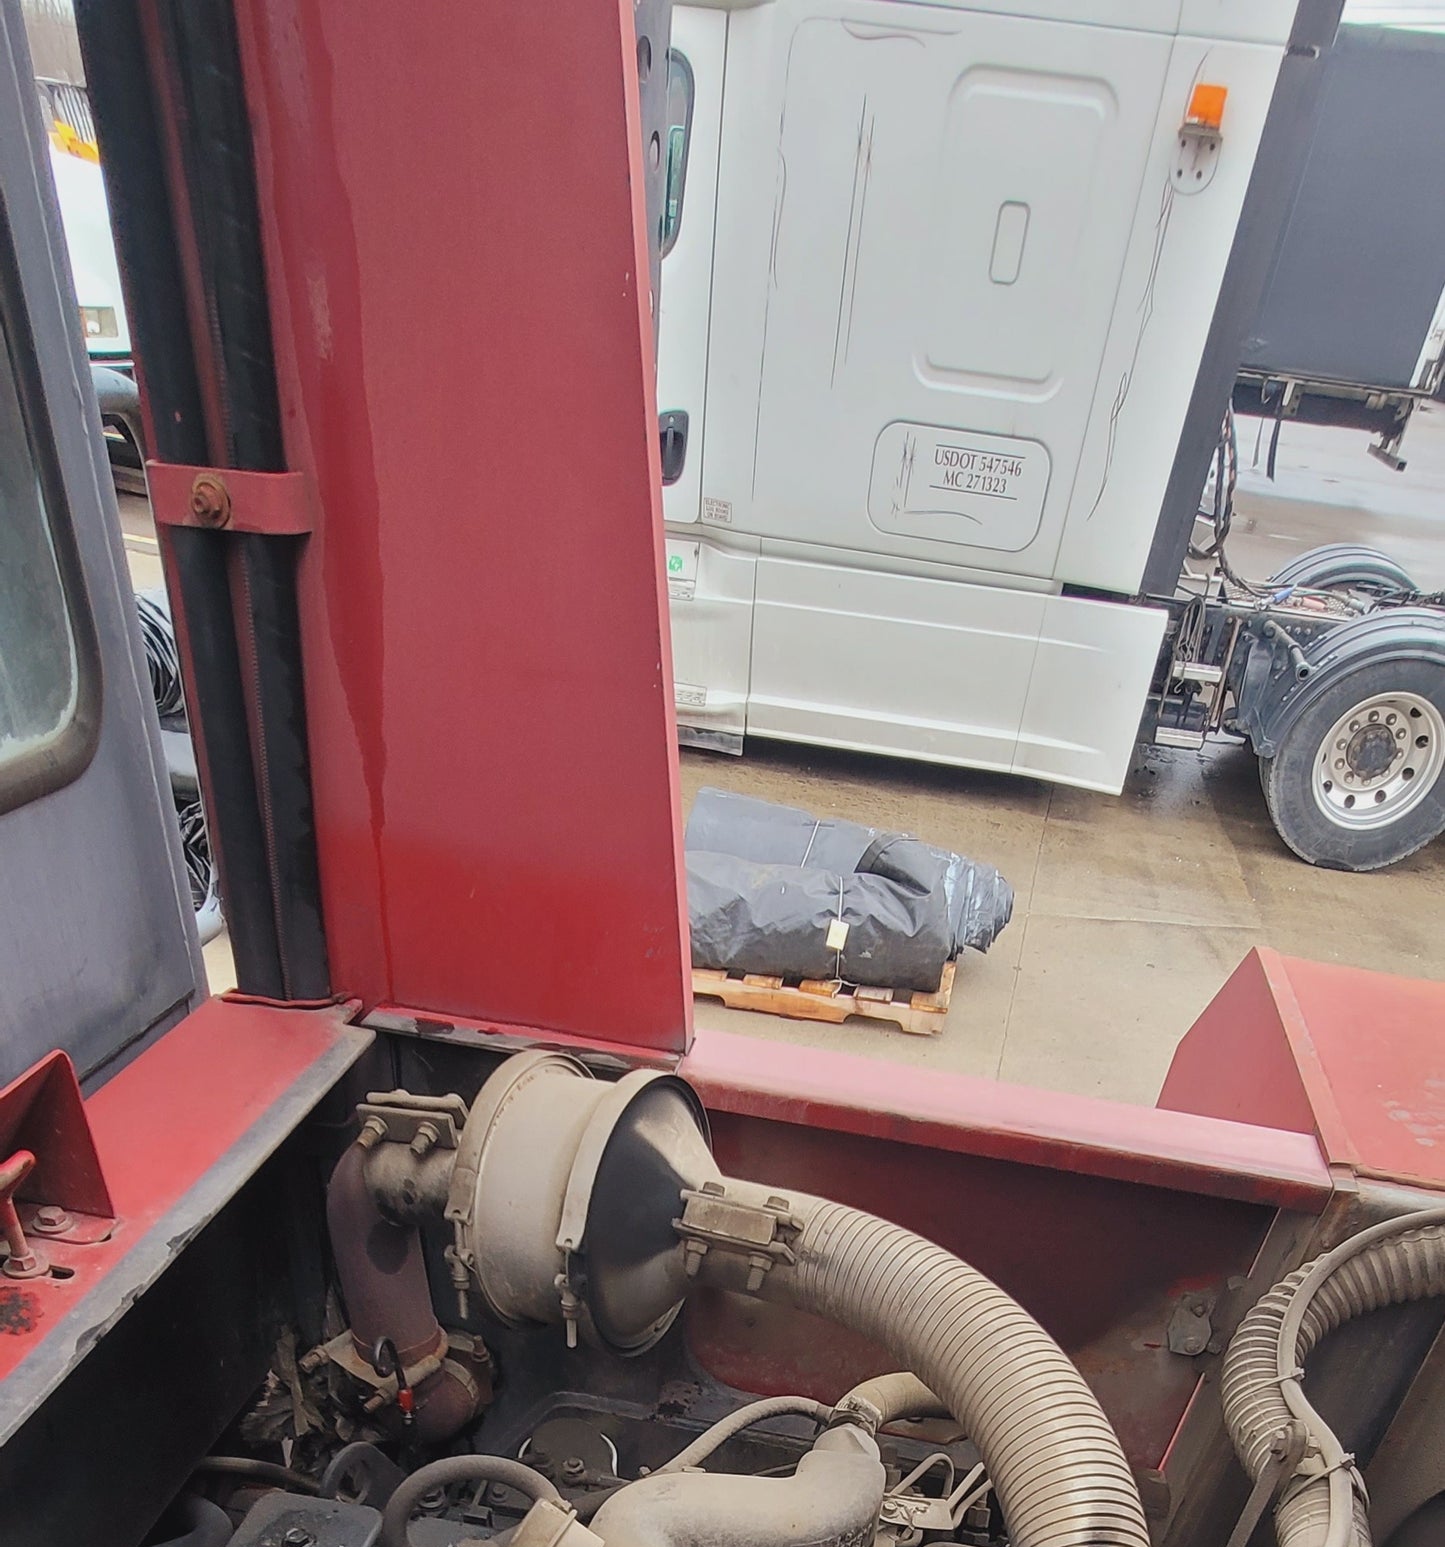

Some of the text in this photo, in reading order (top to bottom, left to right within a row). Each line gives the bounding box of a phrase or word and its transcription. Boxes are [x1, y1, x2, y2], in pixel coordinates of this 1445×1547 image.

[935, 448, 1022, 477] USDOT 547546
[943, 470, 1007, 494] MC 271323
